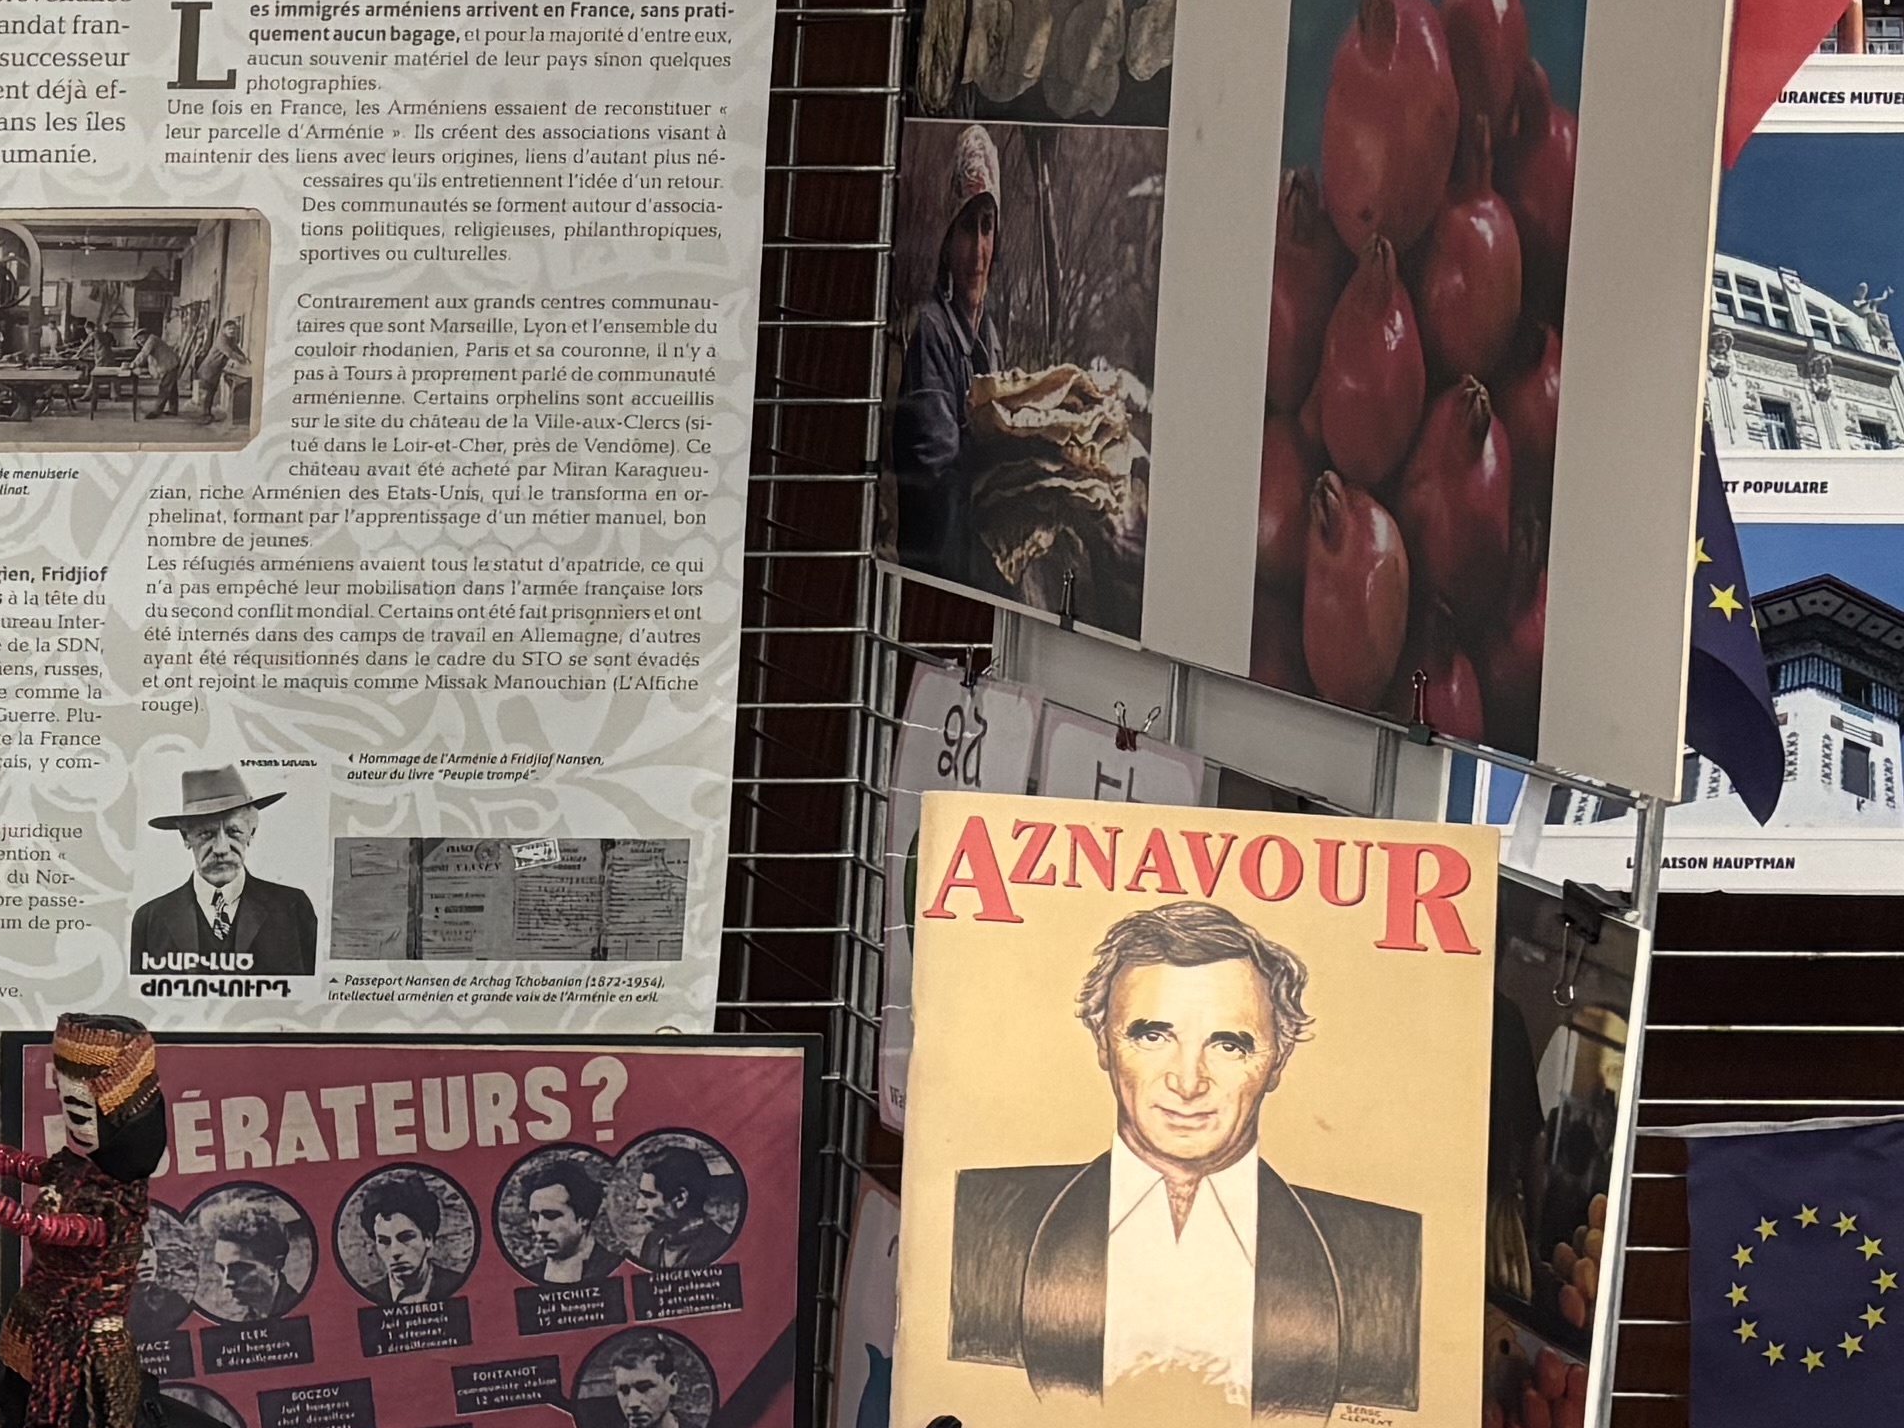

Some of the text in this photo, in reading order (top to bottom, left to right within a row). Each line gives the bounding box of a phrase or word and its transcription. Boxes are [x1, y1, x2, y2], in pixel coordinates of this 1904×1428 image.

[1775, 90, 1846, 106] URANCES
[1743, 480, 1829, 495] POPULAIRE
[1712, 856, 1796, 870] HAUPTMAN
[922, 815, 1481, 956] AZNAVOUR
[160, 1056, 629, 1176] ÉRATEURS?
